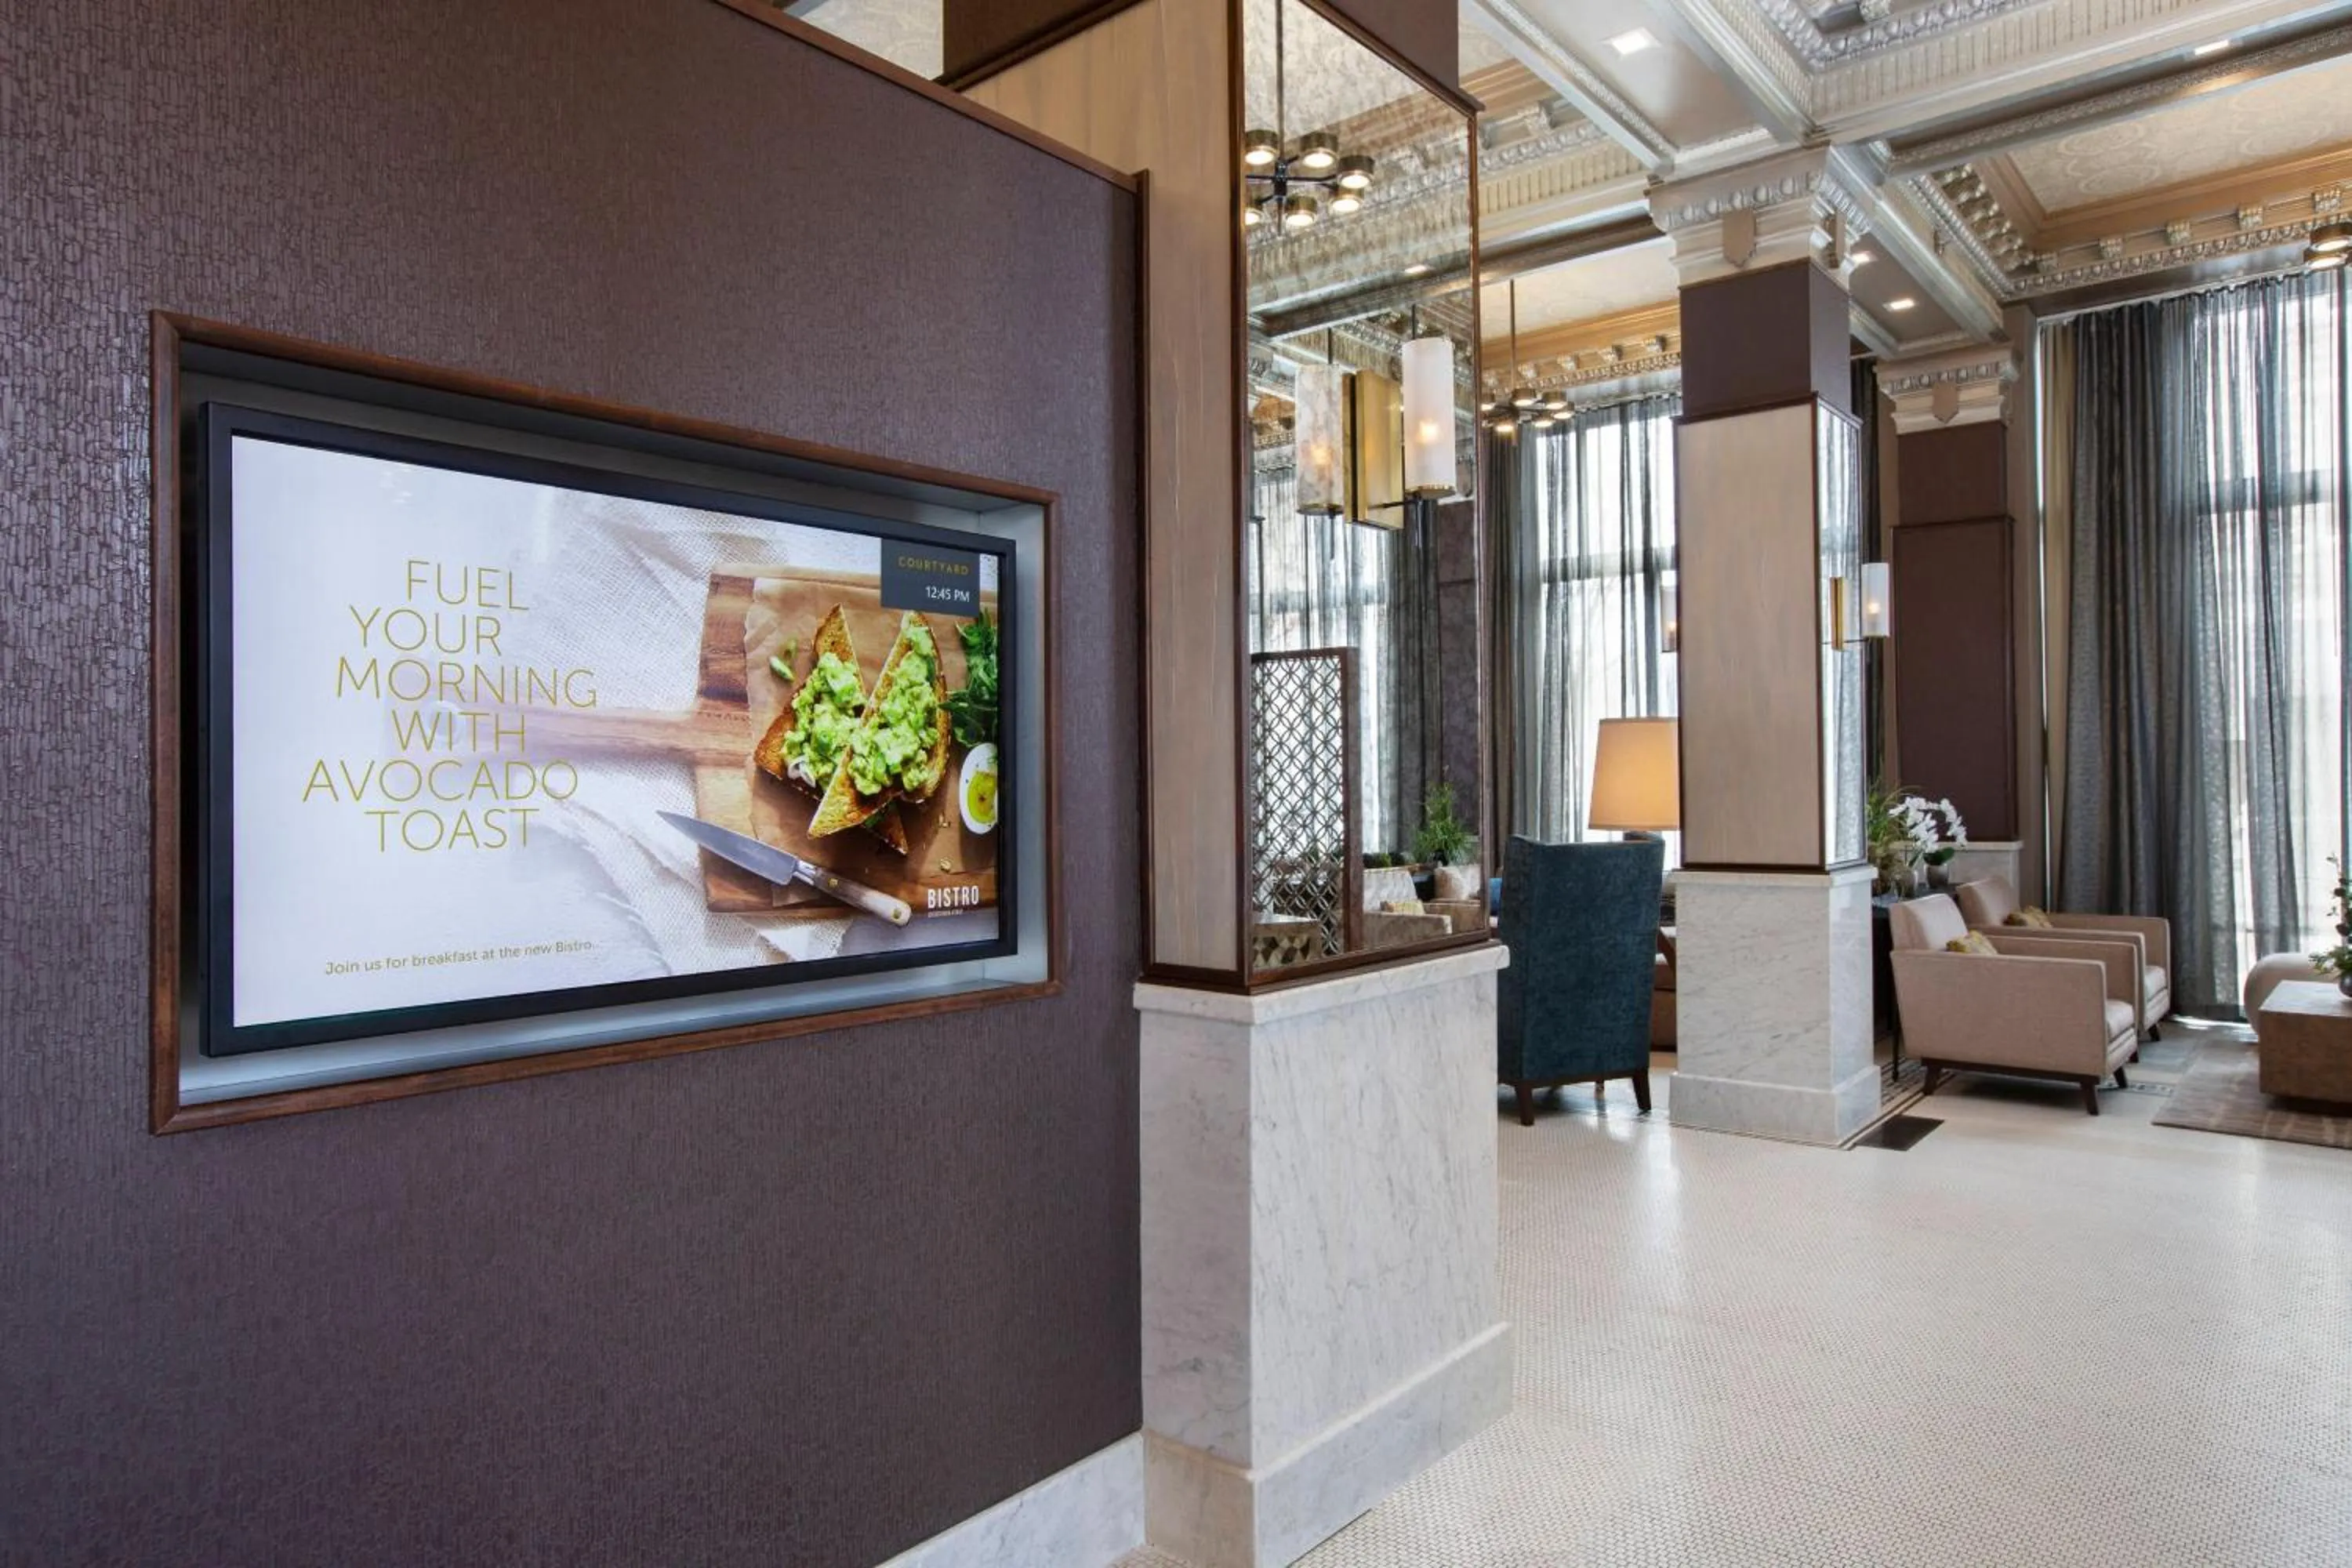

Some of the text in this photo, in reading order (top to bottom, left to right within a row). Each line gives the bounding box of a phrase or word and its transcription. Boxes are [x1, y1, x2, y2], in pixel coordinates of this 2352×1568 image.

[407, 560, 528, 611] FUEL
[898, 556, 970, 575] COURTYARD
[925, 586, 970, 603] 12:45 PM
[350, 604, 502, 656] YOUR
[336, 655, 597, 708] MORNING
[390, 710, 526, 753] WITH
[302, 758, 578, 803] AVOCADO
[365, 808, 540, 852] TOAST
[927, 885, 979, 909] BISTRO
[325, 959, 361, 975] Join
[365, 960, 382, 971] us
[386, 956, 408, 969] for
[412, 949, 478, 967] breakfast
[481, 948, 495, 960] at
[499, 946, 521, 958] the
[524, 943, 553, 956] new
